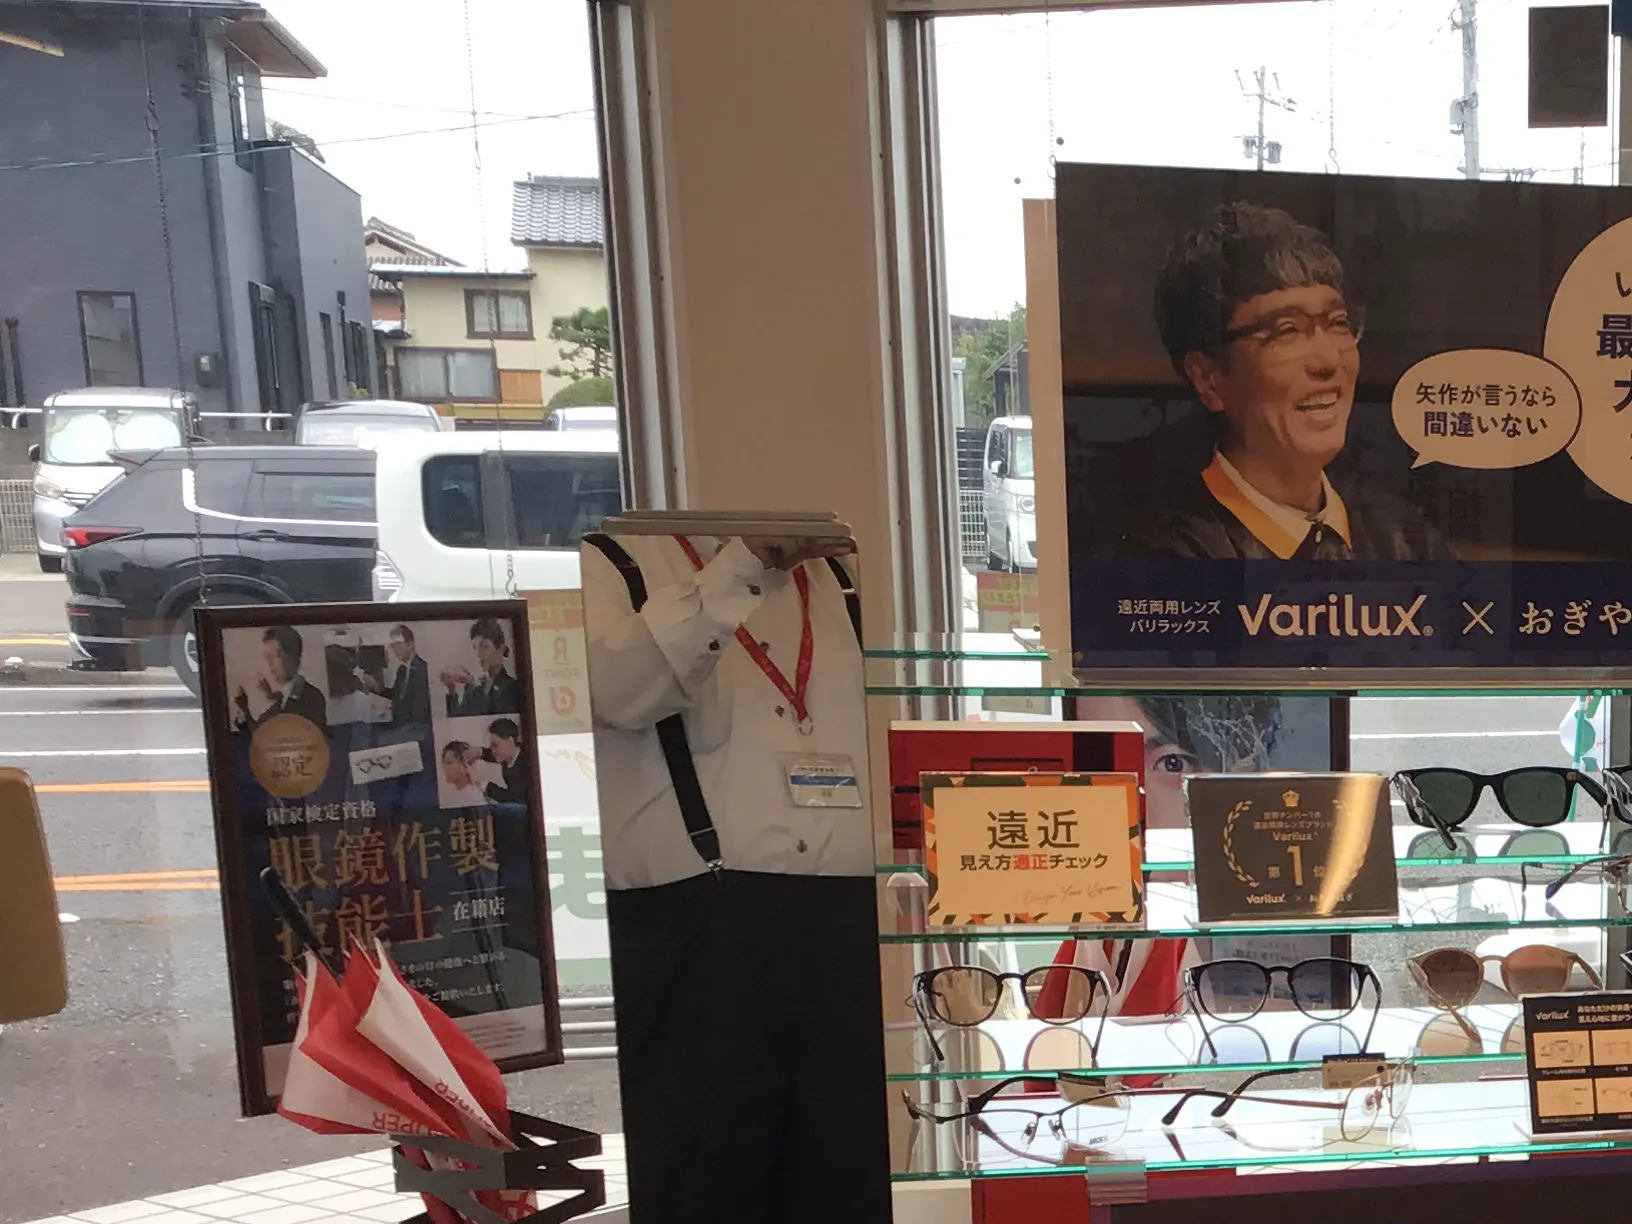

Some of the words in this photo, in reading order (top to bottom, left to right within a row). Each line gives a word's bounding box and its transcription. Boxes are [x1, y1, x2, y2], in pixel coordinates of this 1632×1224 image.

[1415, 382, 1557, 408] 矢作が言うなら
[1423, 412, 1549, 438] 間違いない
[1117, 599, 1221, 616] 遠近両用レンズ
[986, 809, 1080, 850] 遠近
[268, 817, 500, 892] 眼鏡作製
[959, 852, 1109, 872] 見え方適正チェック
